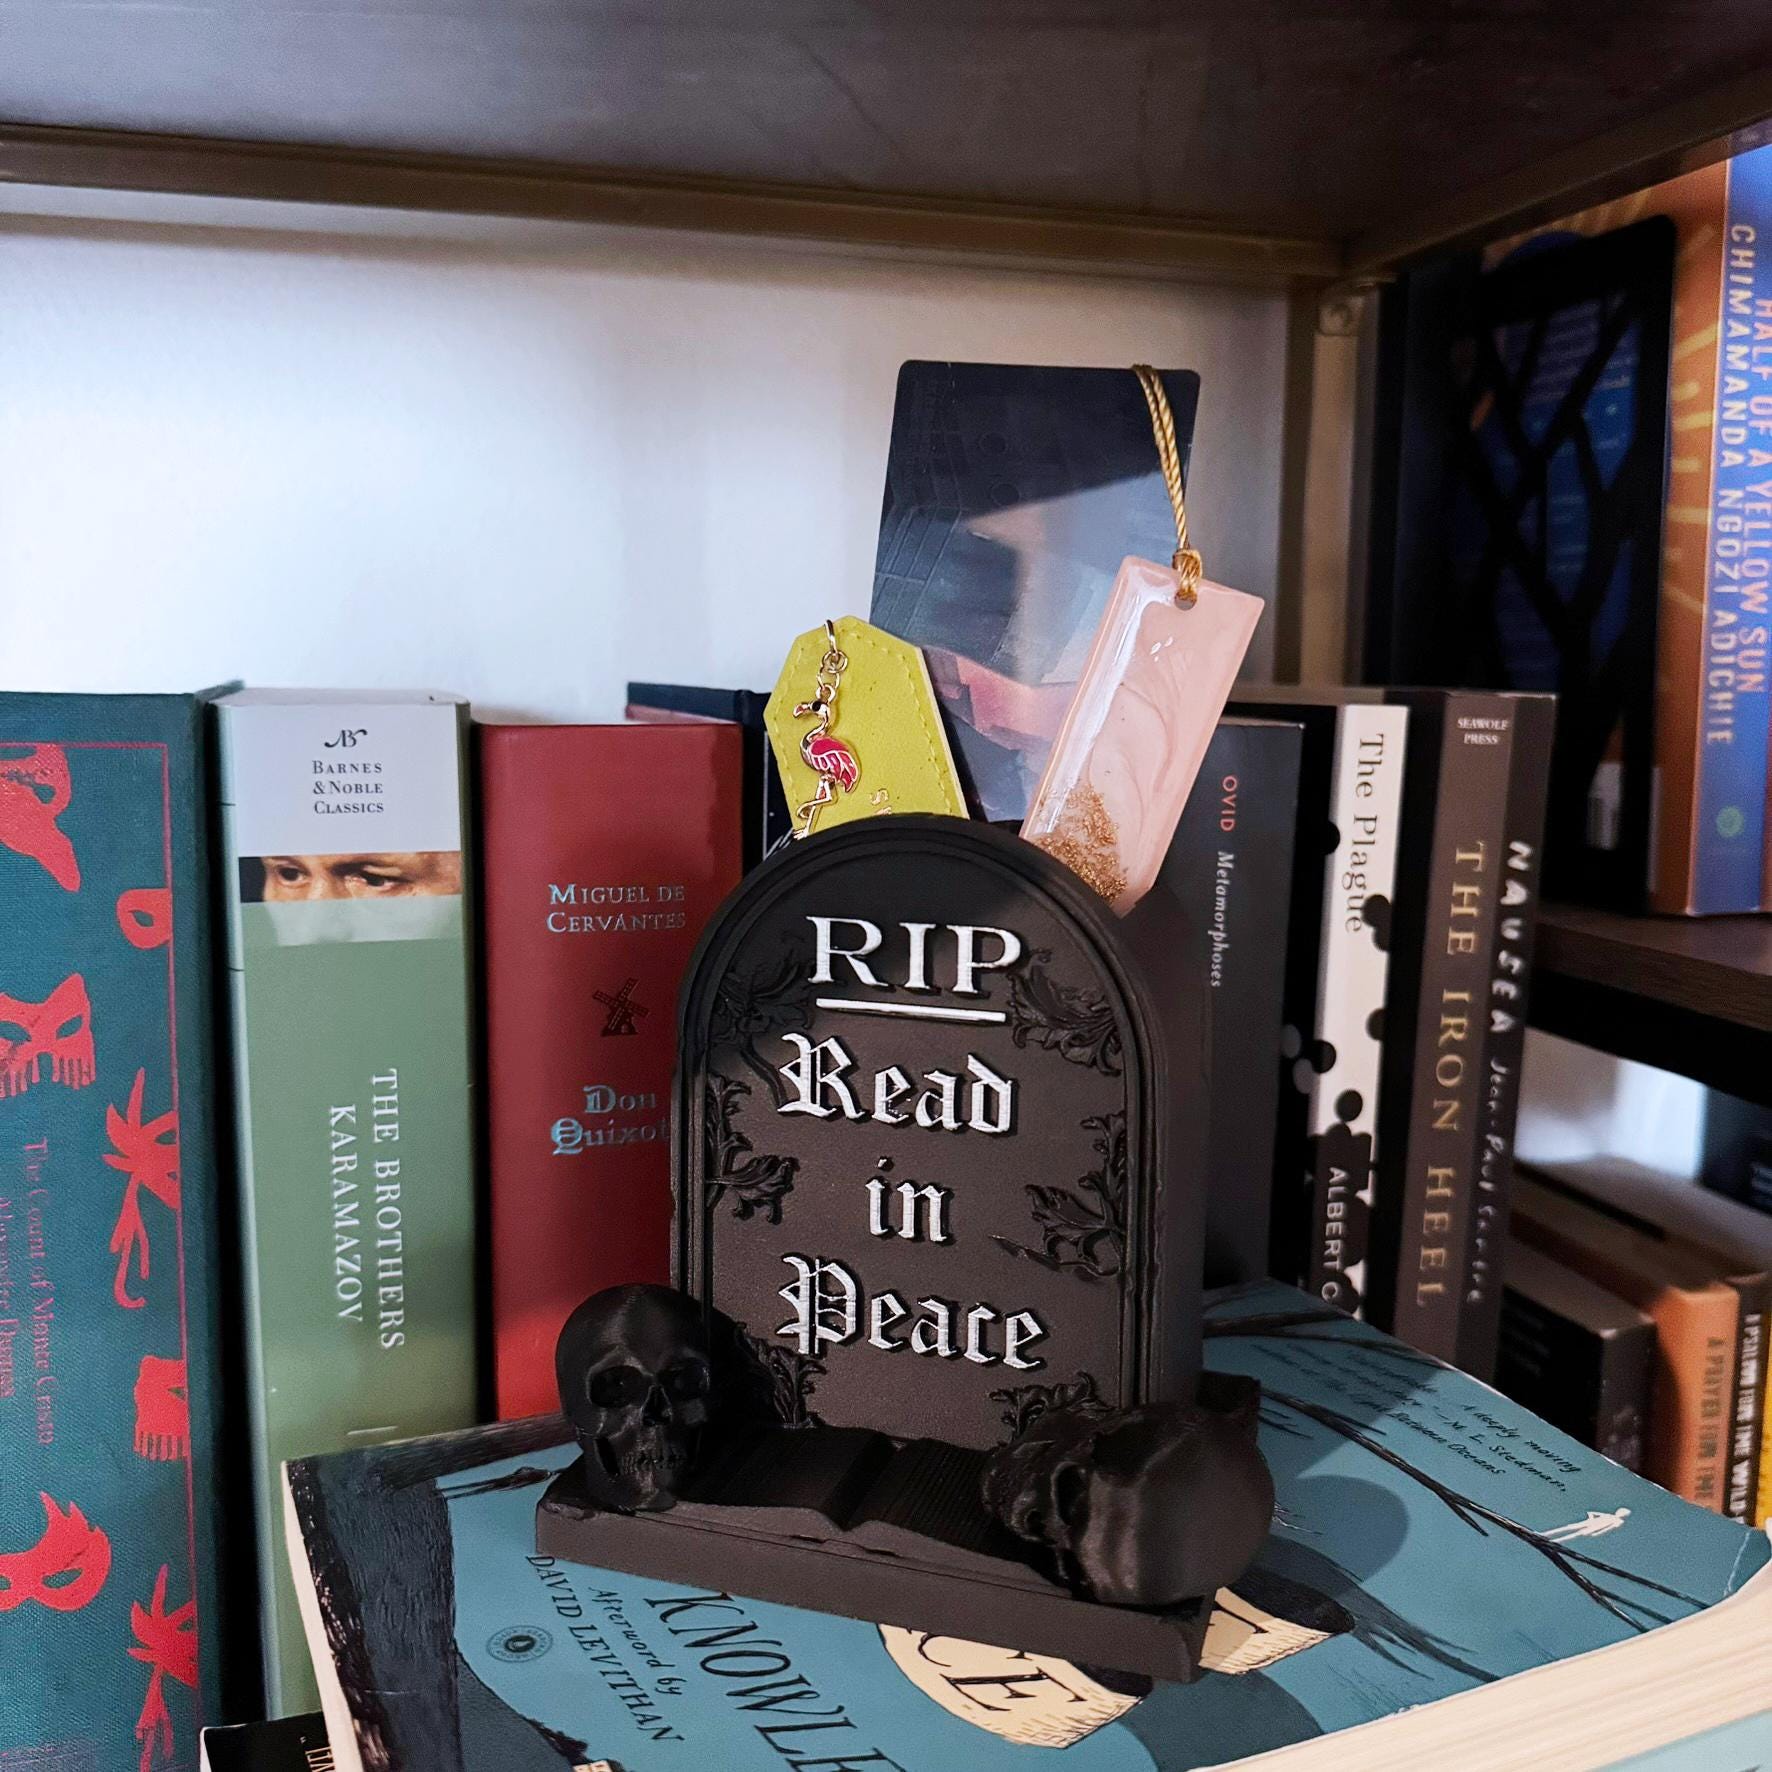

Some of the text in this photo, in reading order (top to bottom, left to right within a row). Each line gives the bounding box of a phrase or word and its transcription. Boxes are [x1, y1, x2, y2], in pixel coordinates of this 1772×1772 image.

[1707, 224, 1756, 745] CHIMAMANDA NGOZI ADICHIE
[1735, 299, 1772, 694] HALF OF A YELLOW SUN
[312, 759, 383, 775] BARNES
[313, 780, 383, 795] & NOBLE
[1463, 733, 1498, 745] PRESS
[314, 800, 384, 815] CLASSICS
[1341, 733, 1384, 933] The Plague
[547, 882, 686, 906] MIGUEL DE
[1207, 775, 1238, 988] OVID Metamorphoses
[804, 915, 1023, 996] RIP
[1490, 840, 1532, 1034] NAUSEA
[583, 1084, 657, 1115] Don
[776, 1032, 1016, 1136] Read
[1416, 841, 1484, 1306] THE IRON HEEL
[23, 1137, 49, 1183] The
[550, 1115, 670, 1156] Quixot
[329, 1104, 364, 1323] KARAMAZOV
[371, 1067, 406, 1350] THE BROTHERS
[865, 1157, 948, 1242] in
[1323, 1167, 1348, 1272] ALBERT
[32, 1297, 55, 1370] Monte
[776, 1255, 1044, 1370] Peace
[1473, 1411, 1521, 1438] deeply
[1524, 1439, 1581, 1474] moving
[525, 1554, 686, 1742] DAVID LEVITHAN
[588, 1586, 688, 1696] Afterword by
